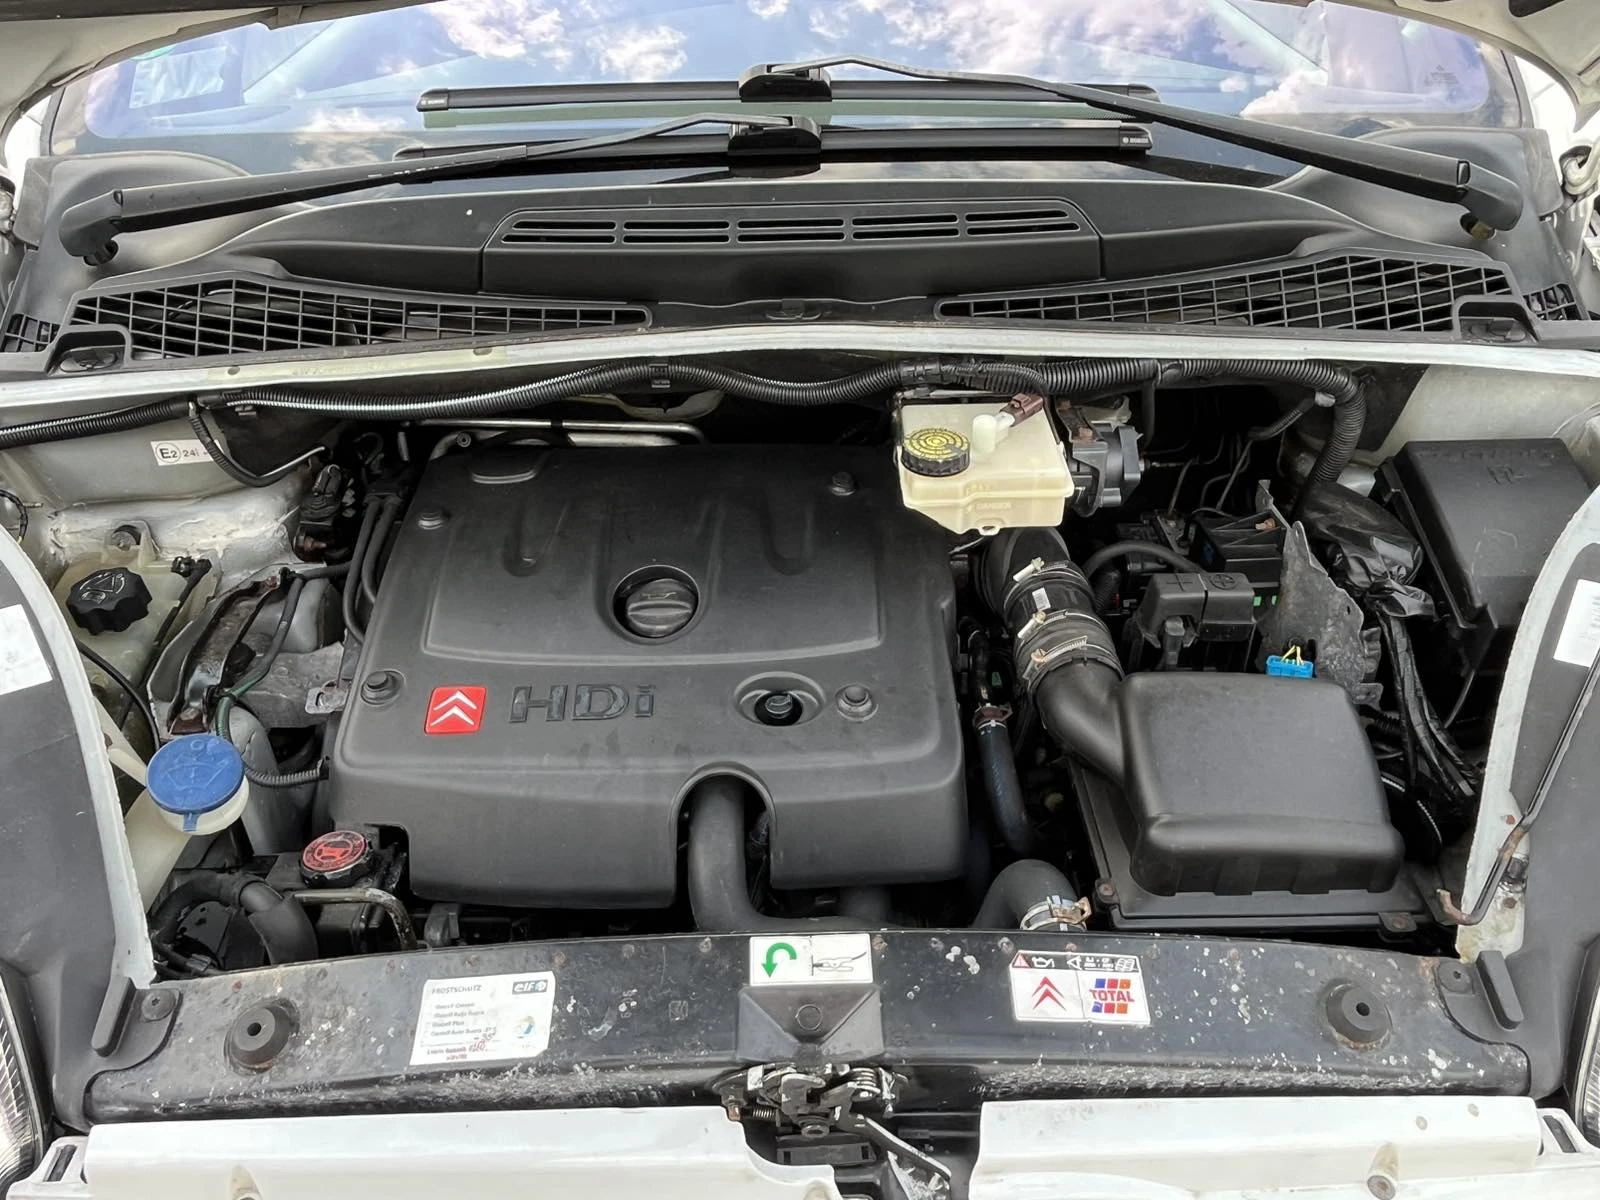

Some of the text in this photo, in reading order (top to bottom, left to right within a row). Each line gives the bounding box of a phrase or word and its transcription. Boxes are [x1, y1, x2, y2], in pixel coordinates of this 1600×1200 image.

[508, 683, 656, 724] HDi
[513, 982, 535, 992] elf
[1089, 989, 1135, 1002] TOTAL
